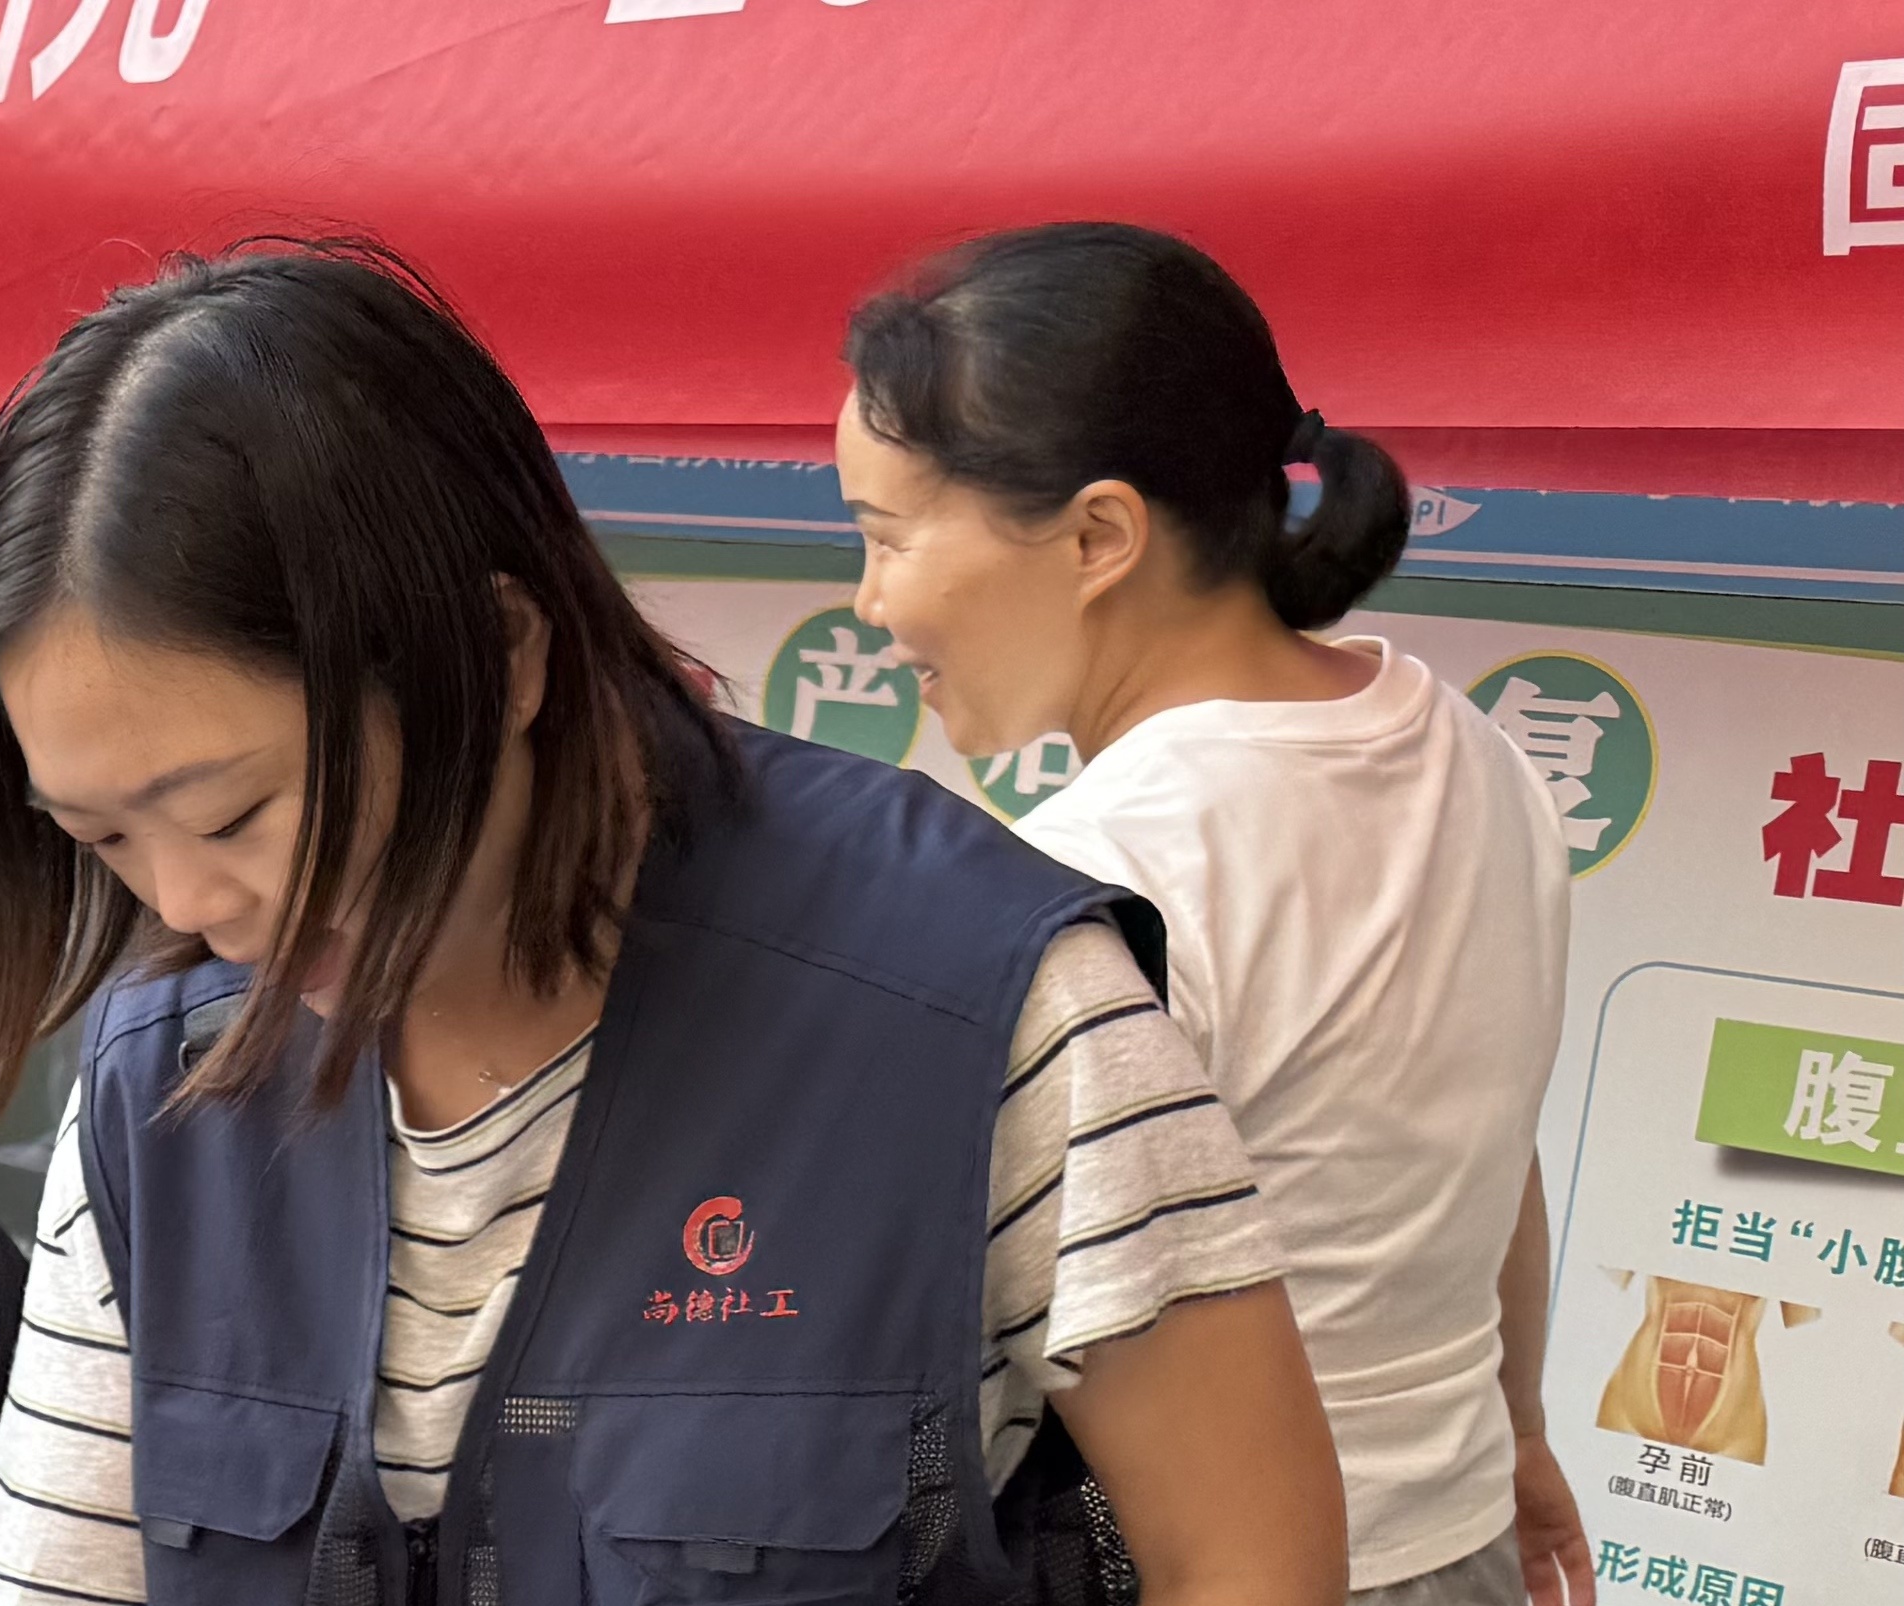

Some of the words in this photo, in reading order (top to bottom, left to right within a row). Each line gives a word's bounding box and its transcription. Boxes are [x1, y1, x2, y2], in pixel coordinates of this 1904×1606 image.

[1782, 1048, 1904, 1155] 腹
[1637, 1443, 1715, 1487] 孕前
[1607, 1474, 1733, 1523] (腹直肌正常)
